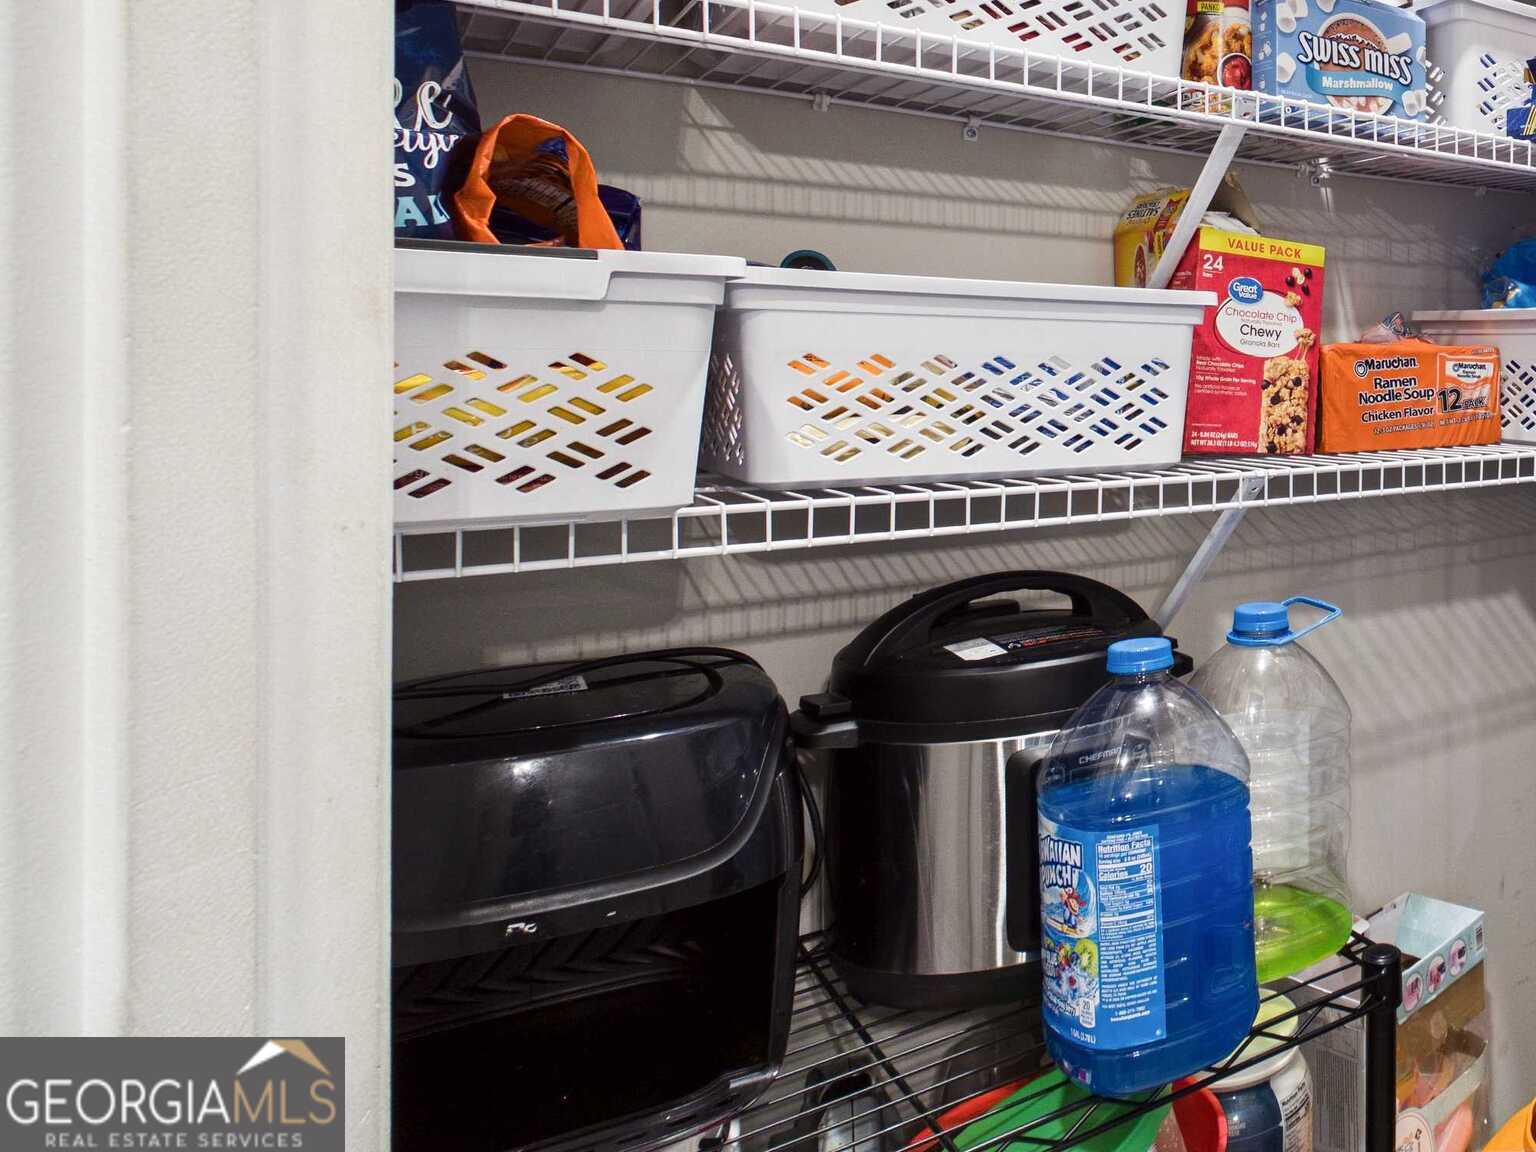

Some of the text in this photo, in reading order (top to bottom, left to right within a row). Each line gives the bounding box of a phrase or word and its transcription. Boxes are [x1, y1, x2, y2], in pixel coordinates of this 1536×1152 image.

[1297, 30, 1413, 86] SWISS MISS
[1321, 76, 1394, 93] Marshmallow
[1227, 237, 1303, 259] VALUE PACK
[1202, 253, 1224, 271] 24
[1232, 281, 1258, 295] Great
[1238, 291, 1258, 300] Value
[1224, 307, 1297, 325] Chocolate Chip
[1239, 323, 1282, 341] Chewy
[1239, 338, 1267, 347] Granola
[1364, 356, 1418, 371] Maruchan
[1457, 362, 1487, 371] Maruchan
[1373, 376, 1418, 390] Ramen
[1358, 387, 1436, 405] Noodle Soup
[1437, 387, 1462, 414] 12
[1361, 406, 1434, 423] Chicken Flavor
[1078, 746, 1122, 765] CHEFMAN
[1097, 838, 1151, 854] Nutrition Facts
[1099, 862, 1153, 880] Calories 20
